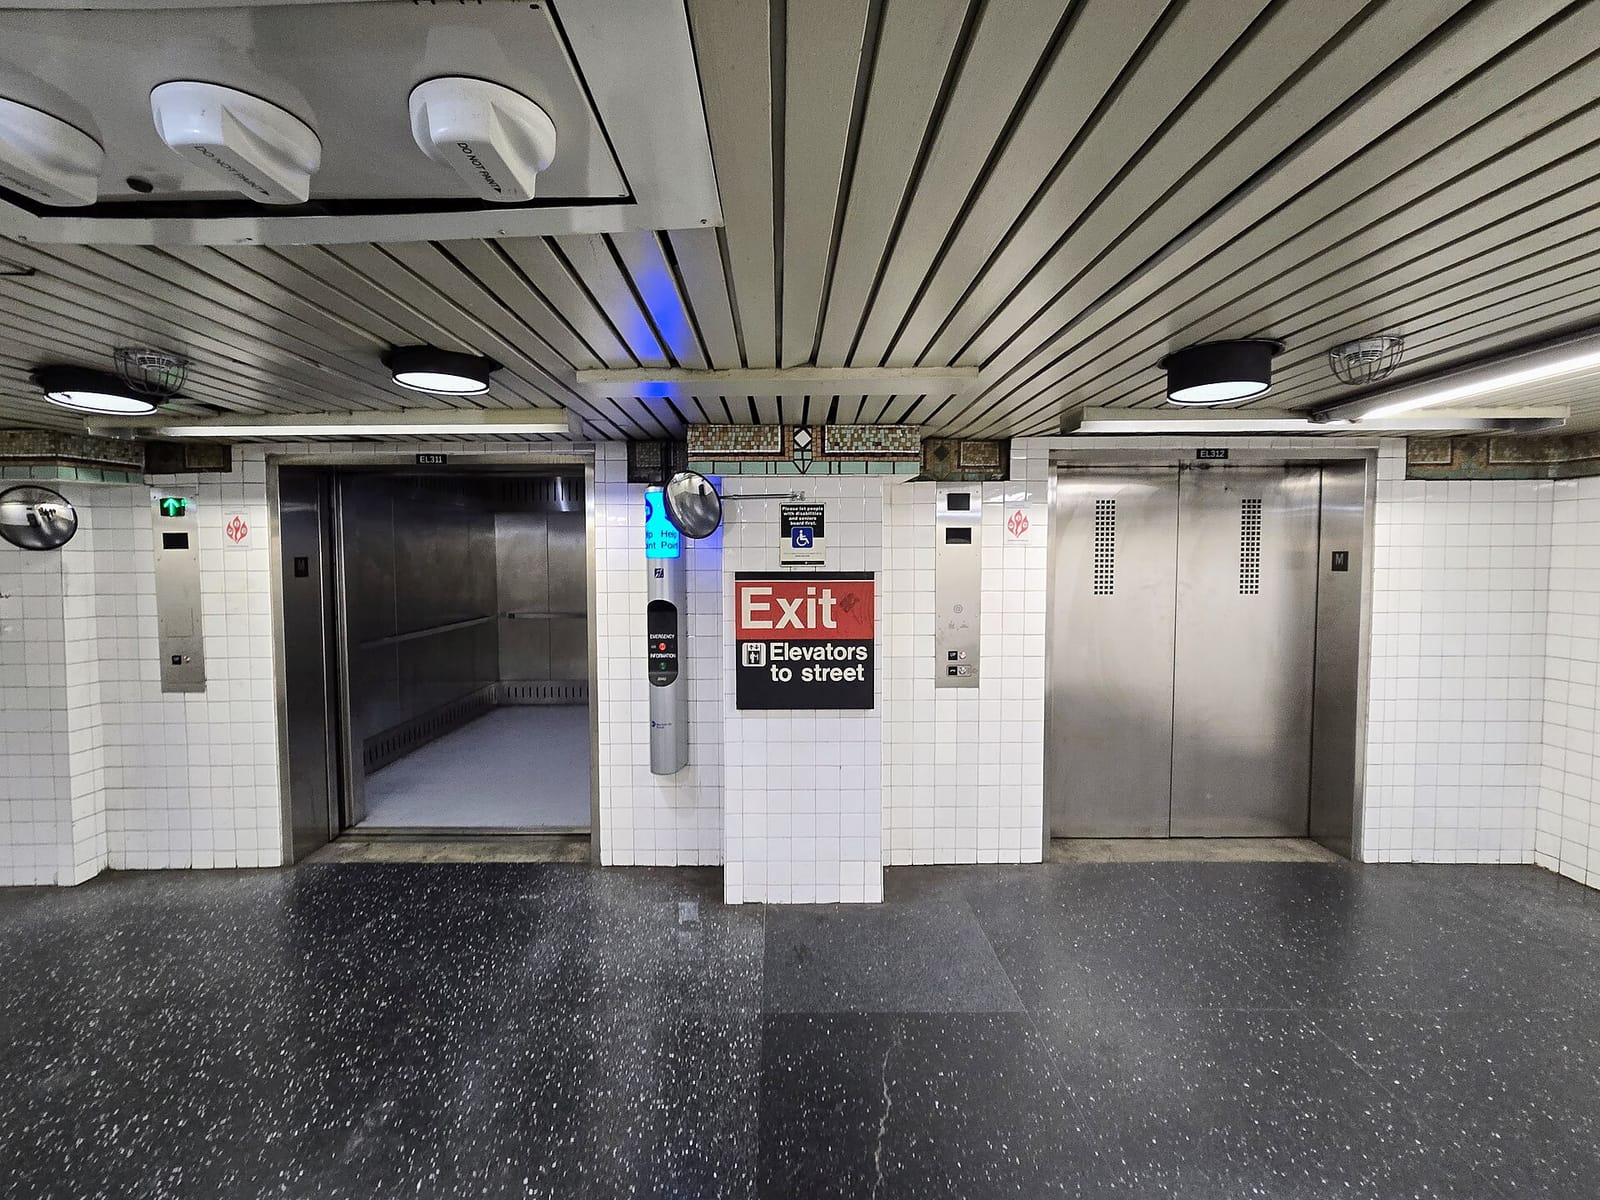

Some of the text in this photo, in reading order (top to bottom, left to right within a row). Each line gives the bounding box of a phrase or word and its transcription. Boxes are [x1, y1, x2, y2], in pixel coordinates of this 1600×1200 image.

[194, 146, 215, 157] DO
[457, 142, 501, 189] DO NOT PAINT
[419, 455, 443, 464] EL311
[1200, 450, 1225, 458] EL312
[1335, 553, 1344, 565] M
[741, 586, 838, 629] Exit
[769, 642, 869, 661] Elevators
[770, 663, 865, 682] to street
